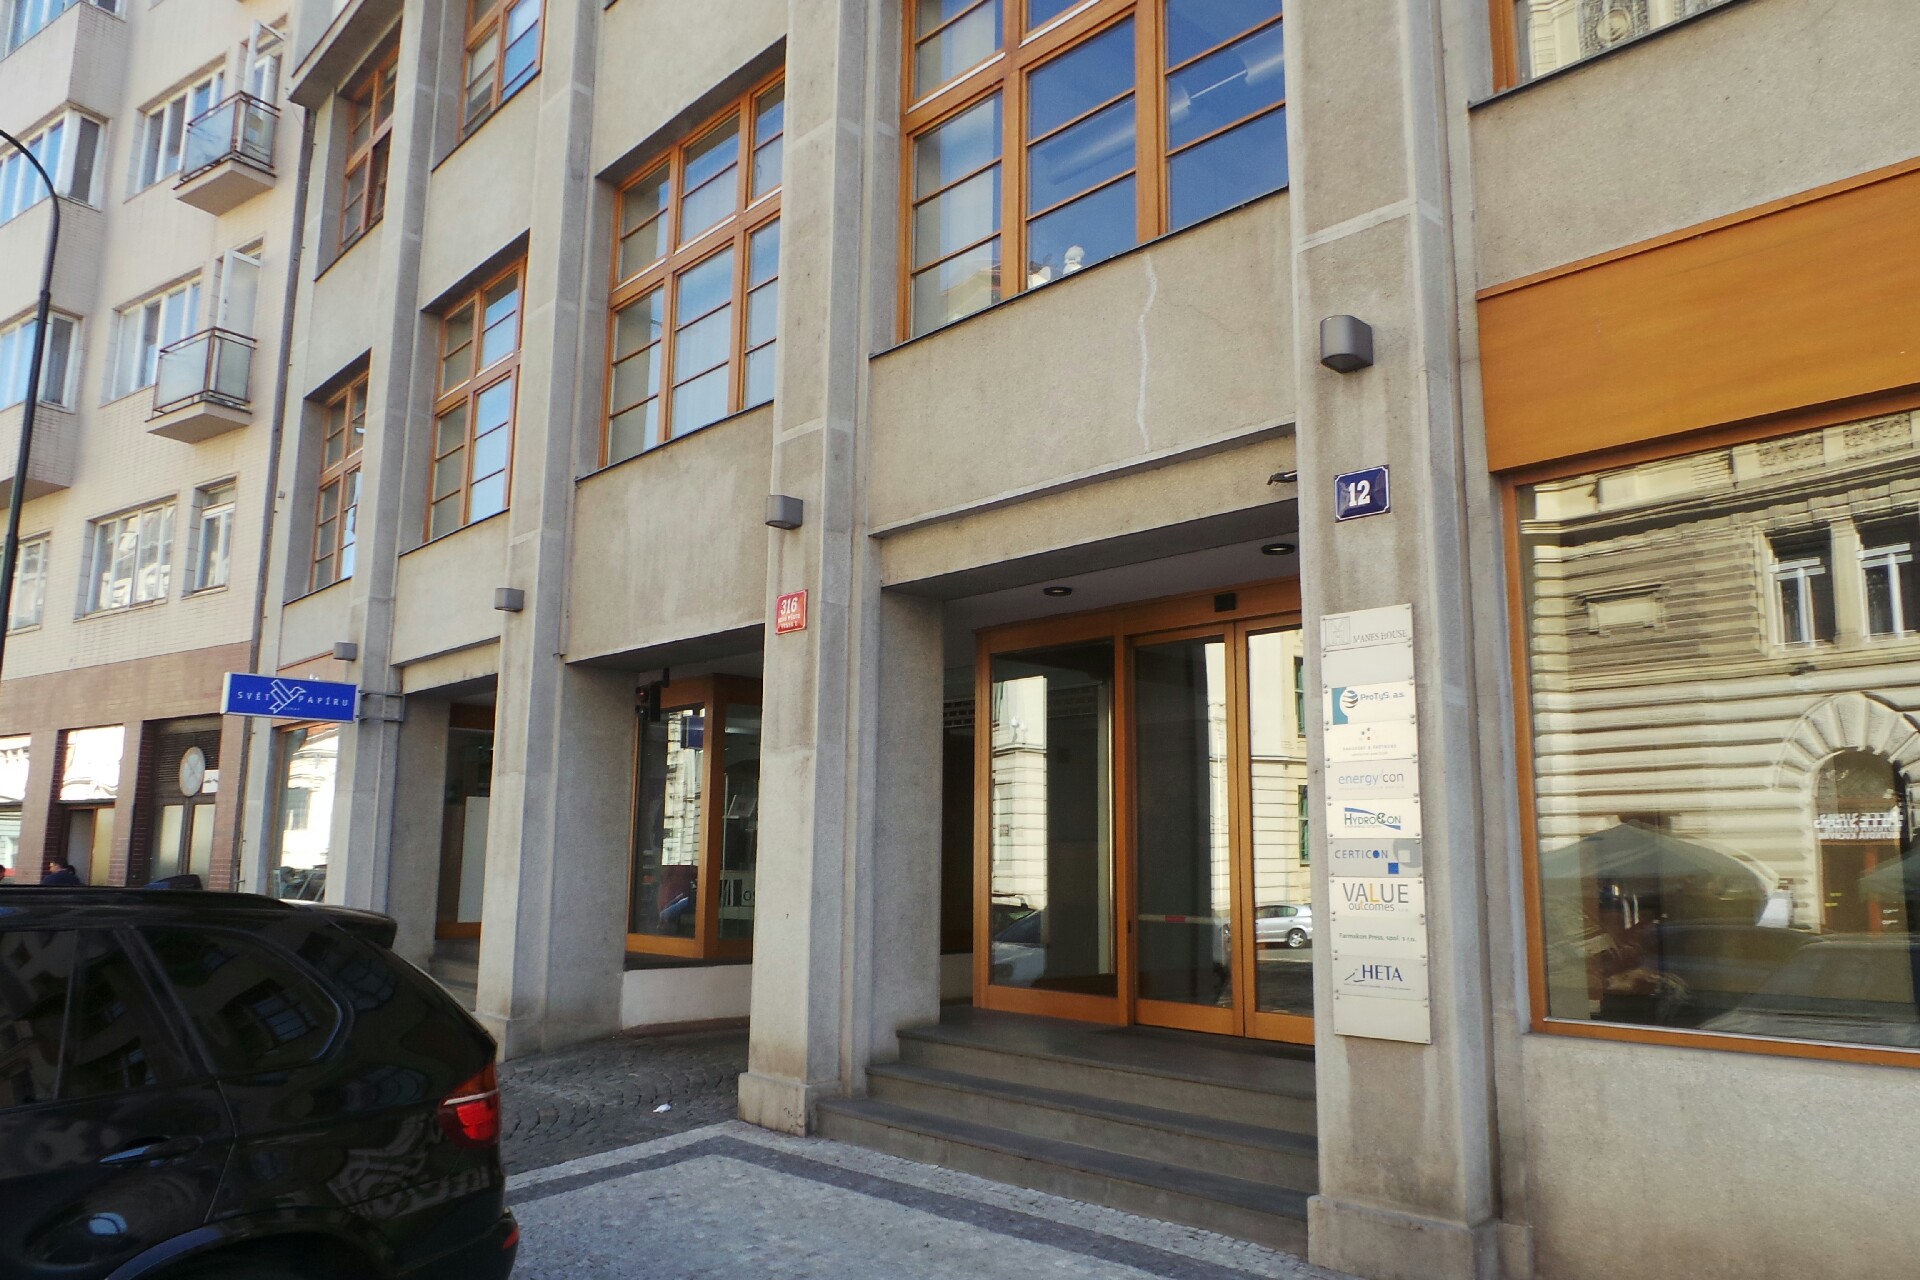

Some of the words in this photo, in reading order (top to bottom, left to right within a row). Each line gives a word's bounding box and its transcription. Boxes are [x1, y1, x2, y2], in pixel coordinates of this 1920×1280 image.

[1348, 480, 1371, 507] 12
[781, 597, 799, 615] 316
[1380, 629, 1408, 641] HOUSE
[298, 695, 349, 707] PAPÍRU
[1338, 771, 1379, 786] energy
[1382, 772, 1405, 783] con
[1334, 849, 1389, 859] CERTICON
[1342, 883, 1409, 904] VALUE
[1349, 899, 1395, 912] outcomes
[1362, 964, 1403, 982] HETA
